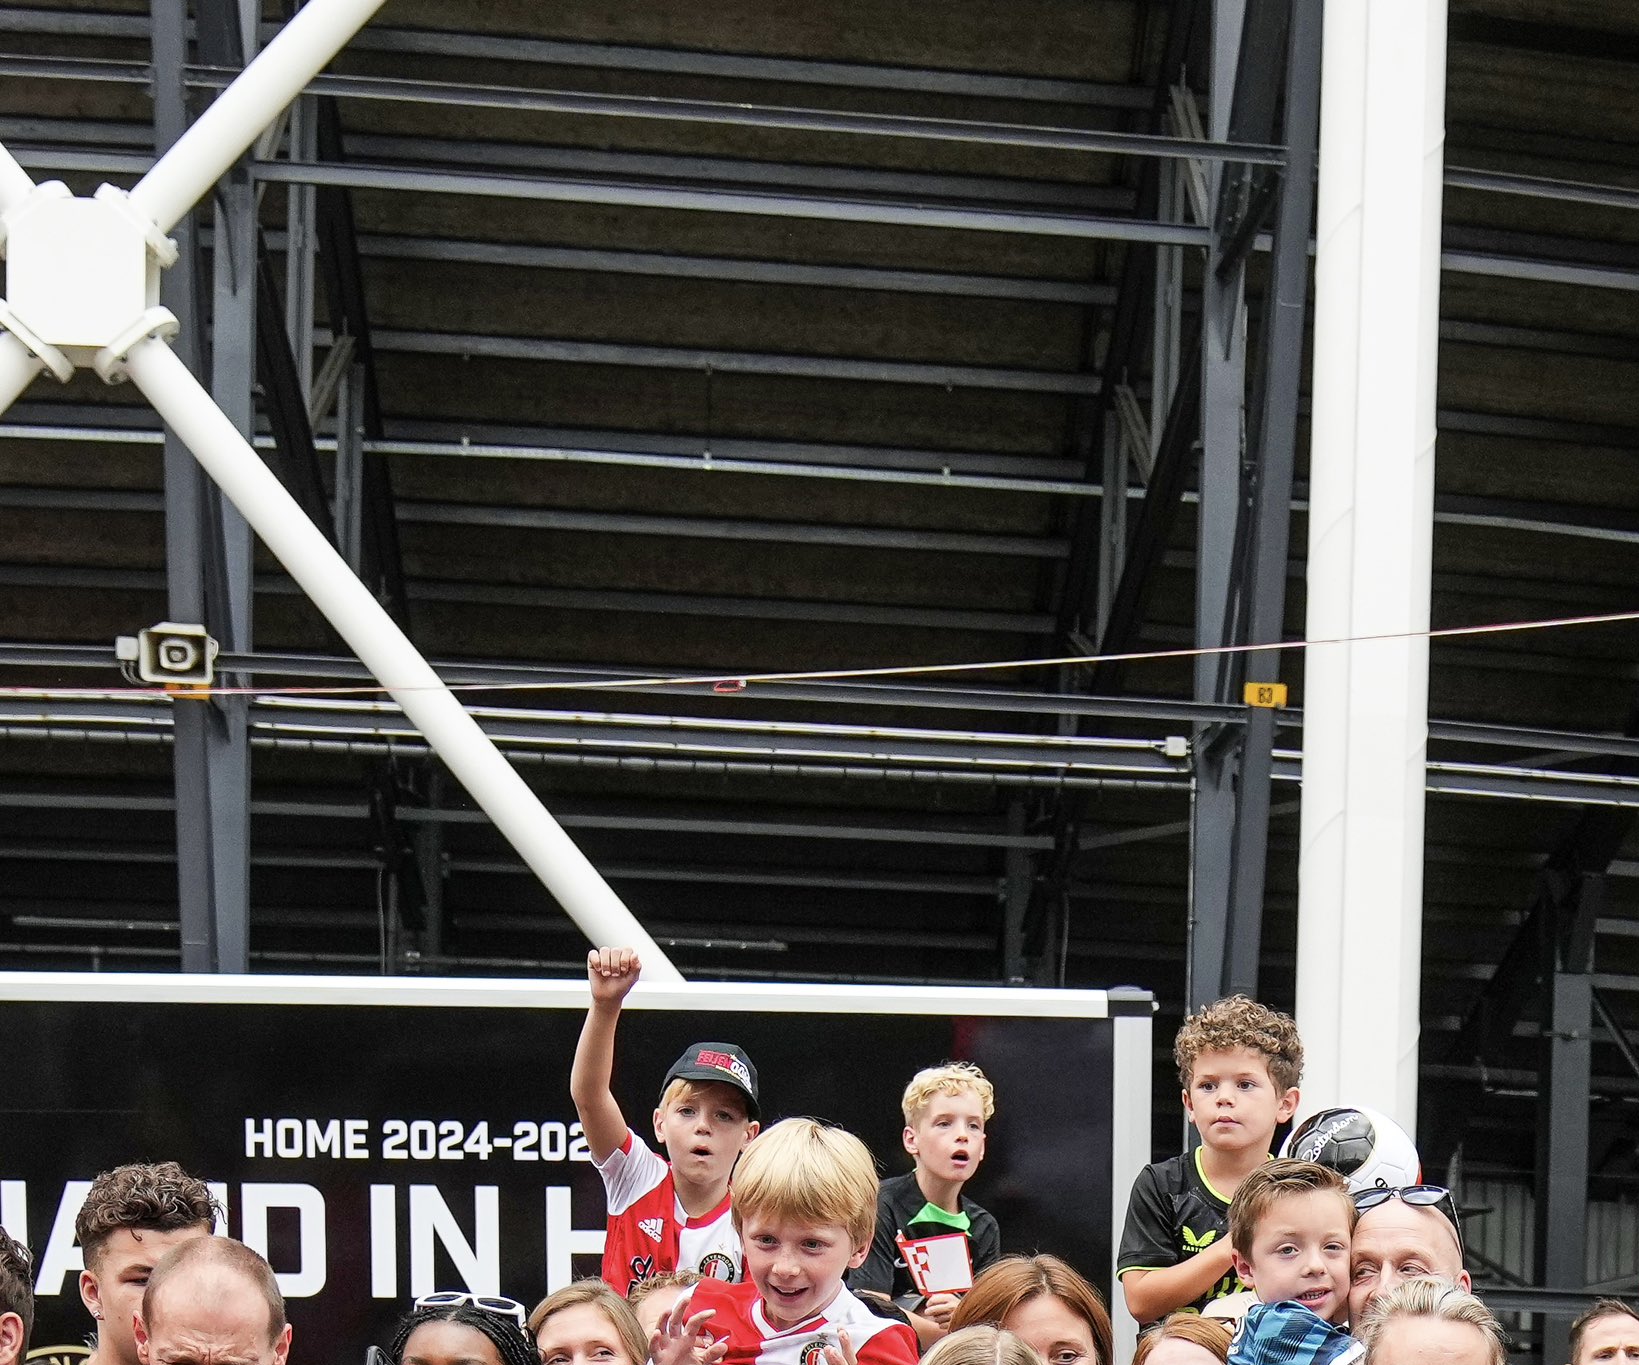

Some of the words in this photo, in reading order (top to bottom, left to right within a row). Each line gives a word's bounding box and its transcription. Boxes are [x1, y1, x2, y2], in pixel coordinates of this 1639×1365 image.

[244, 1117, 370, 1159] HOME
[382, 1120, 594, 1161] 2024-202
[370, 1182, 502, 1299] IN
